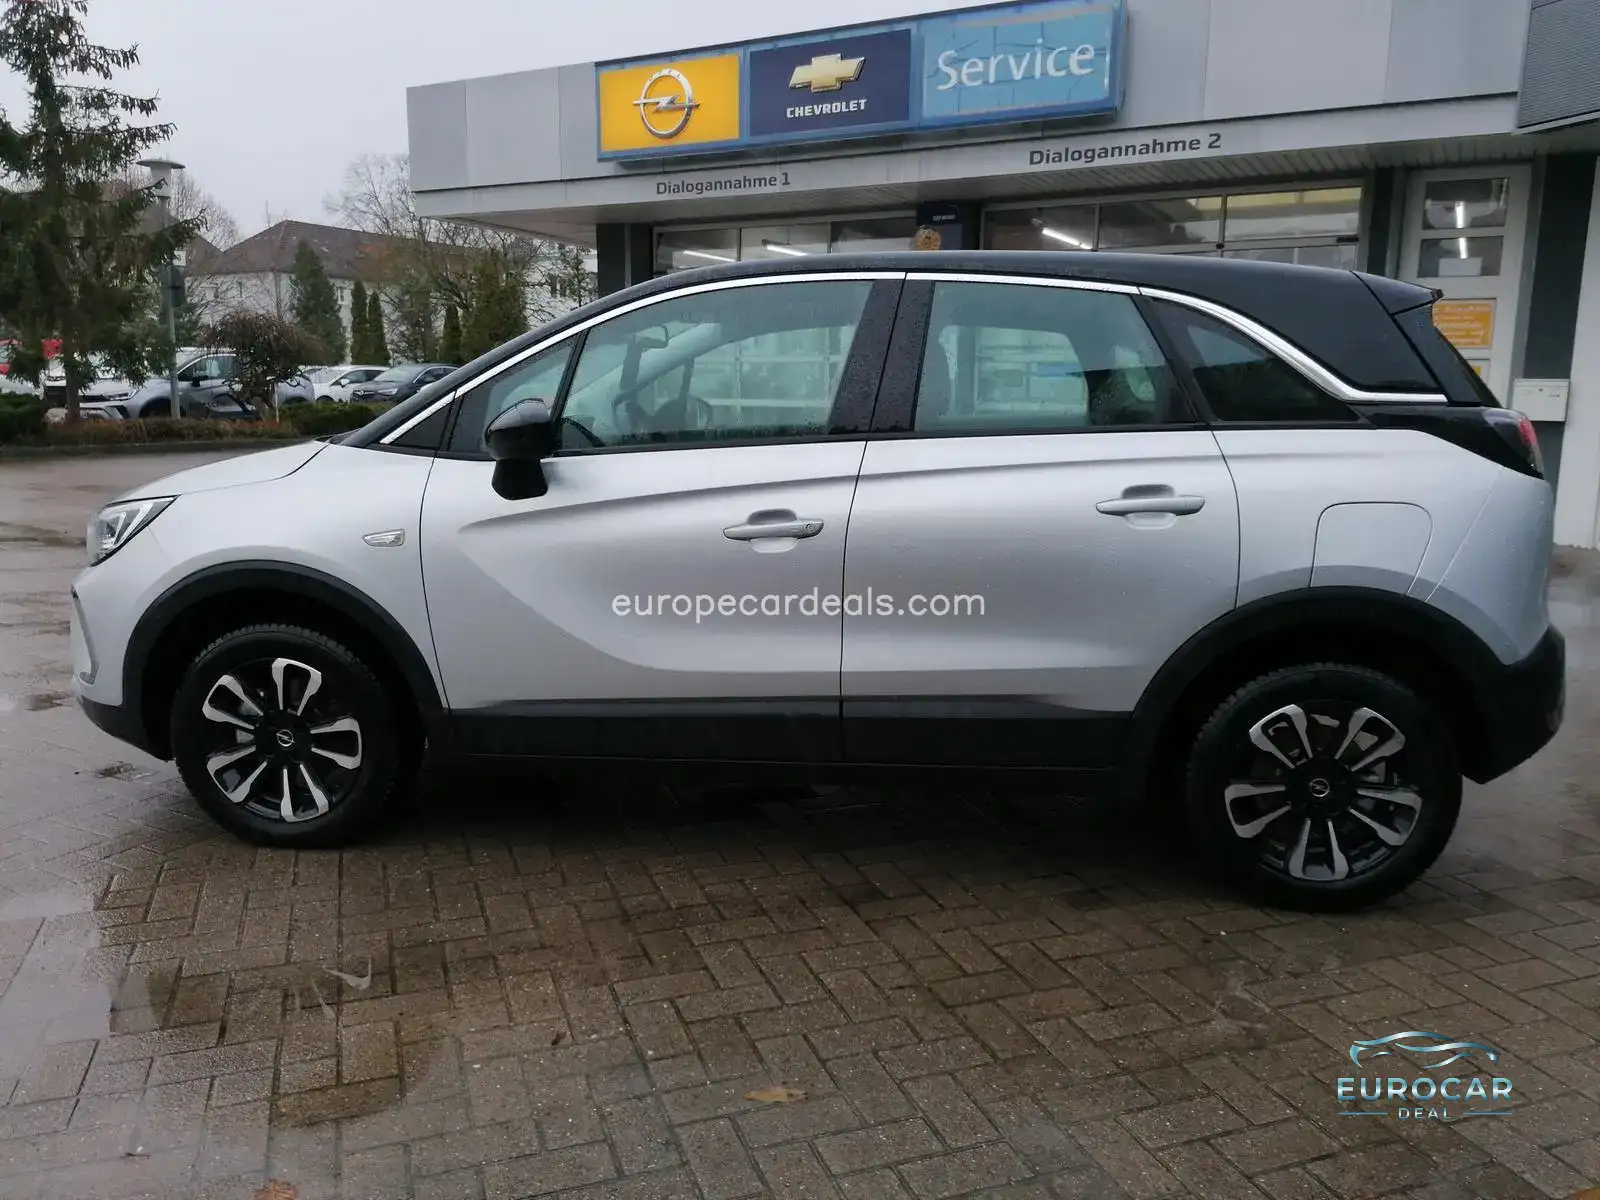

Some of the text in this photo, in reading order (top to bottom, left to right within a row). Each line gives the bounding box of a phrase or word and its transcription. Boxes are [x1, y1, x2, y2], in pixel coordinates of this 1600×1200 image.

[937, 37, 1096, 91] Service
[786, 98, 867, 119] CHEVROLET
[1029, 132, 1222, 166] Dialogannahme 2
[656, 171, 791, 195] Dialogannahme 1
